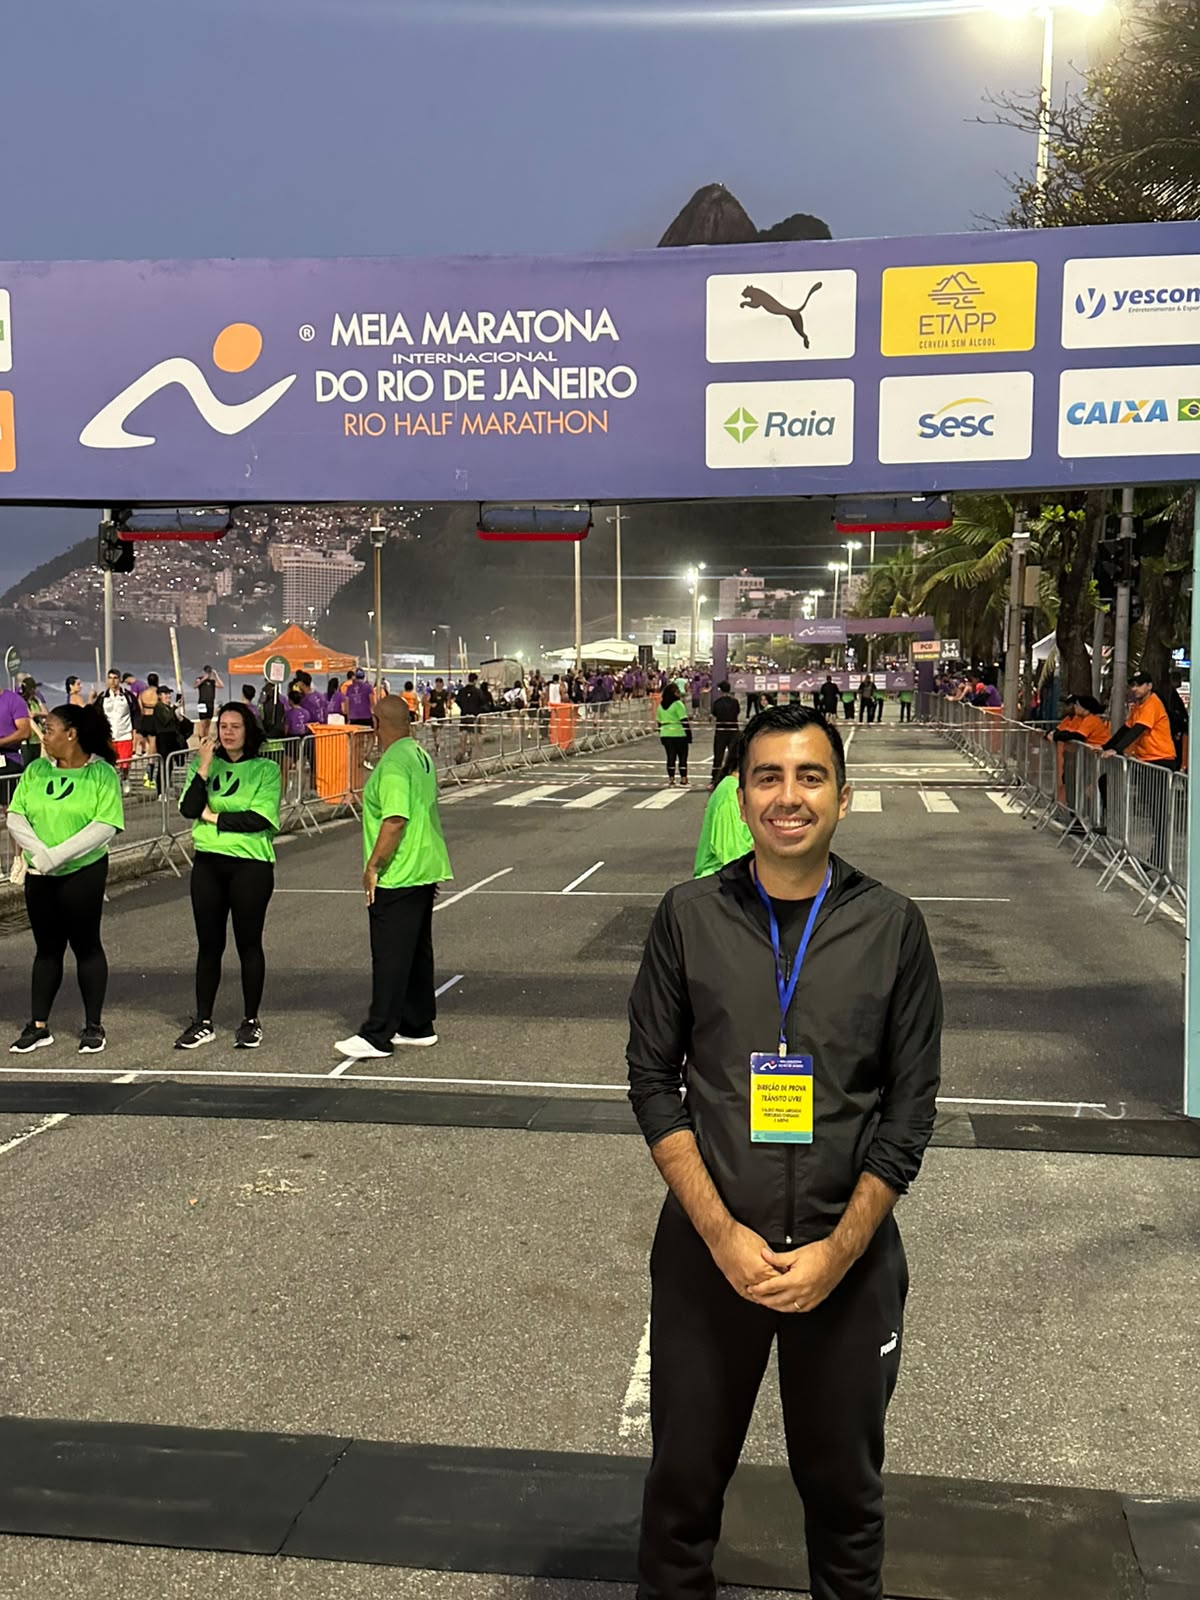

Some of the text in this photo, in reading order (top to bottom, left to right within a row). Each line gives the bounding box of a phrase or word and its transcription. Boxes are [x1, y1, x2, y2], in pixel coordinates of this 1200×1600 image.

[331, 312, 414, 346] MEIA
[421, 307, 620, 345] MARATONA
[919, 312, 997, 335] ETAPP
[919, 337, 996, 349] CERVEJA SEM ÁLCOOL
[392, 351, 558, 364] INTERNACIONAL
[315, 365, 638, 402] DO RIO DE JANEIRO
[344, 410, 608, 436] RIO HALF MARATHON
[764, 410, 835, 437] Raia
[1066, 399, 1169, 425] CAIXA
[918, 413, 994, 439] Sesc
[757, 1082, 780, 1091] DIREÇÃO
[761, 1093, 787, 1102] TRÂNSITO
